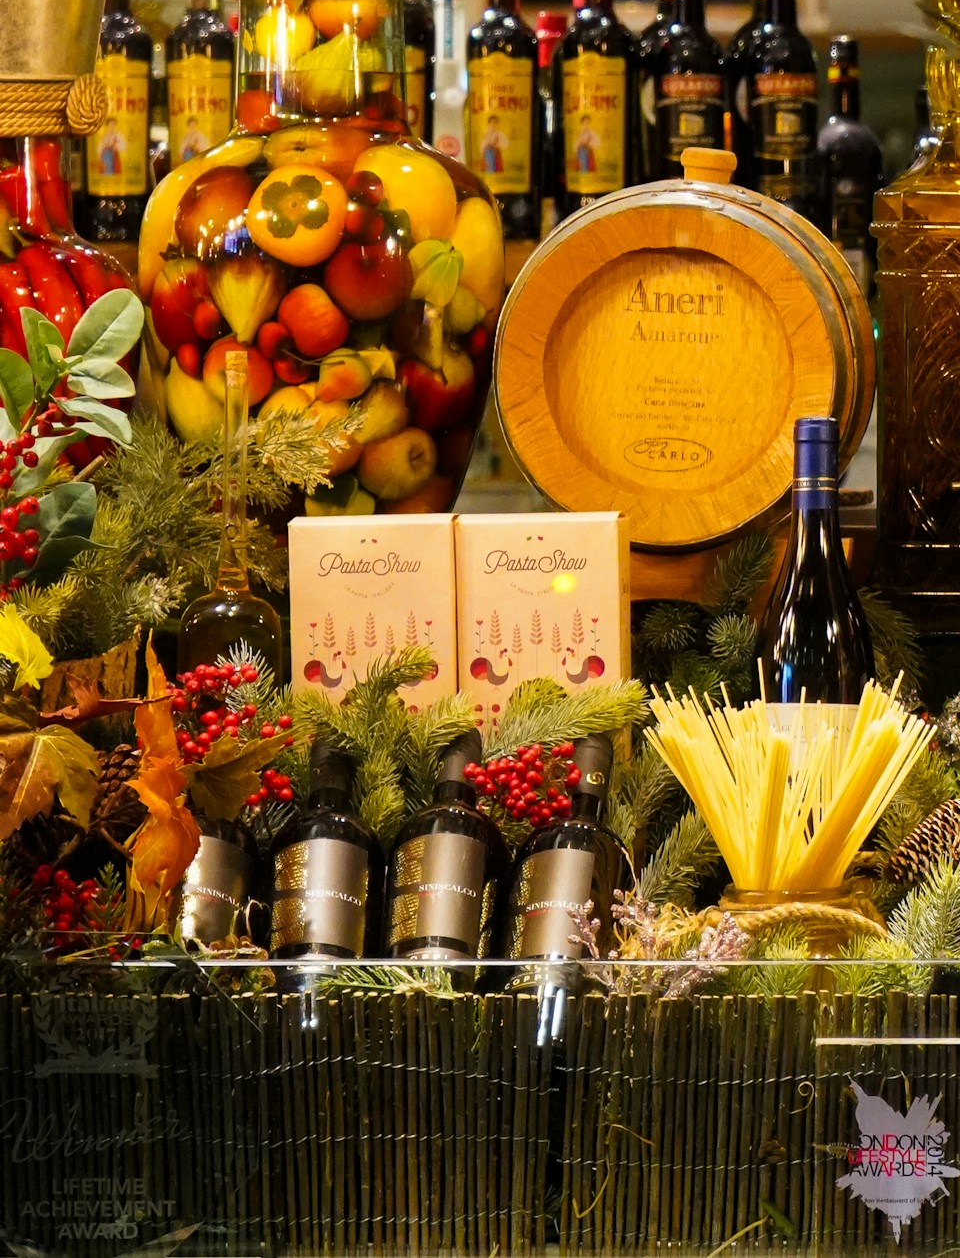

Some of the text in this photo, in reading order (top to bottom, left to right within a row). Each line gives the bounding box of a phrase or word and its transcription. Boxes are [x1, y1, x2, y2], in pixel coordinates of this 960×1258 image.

[623, 278, 725, 318] Aneri
[648, 450, 700, 462] CARLO
[304, 887, 362, 907] SINISCALCO
[418, 883, 477, 898] SINISCALCO
[526, 900, 584, 913] SINISCALCO
[76, 1027, 117, 1042] 2017
[848, 1149, 926, 1164] LIFESTYLE
[927, 1134, 944, 1177] 2014
[850, 1162, 926, 1177] AWARDS
[52, 1178, 146, 1196] LIFETIME
[20, 1200, 177, 1219] ACHIEVEMENT
[57, 1222, 139, 1240] AWARD
